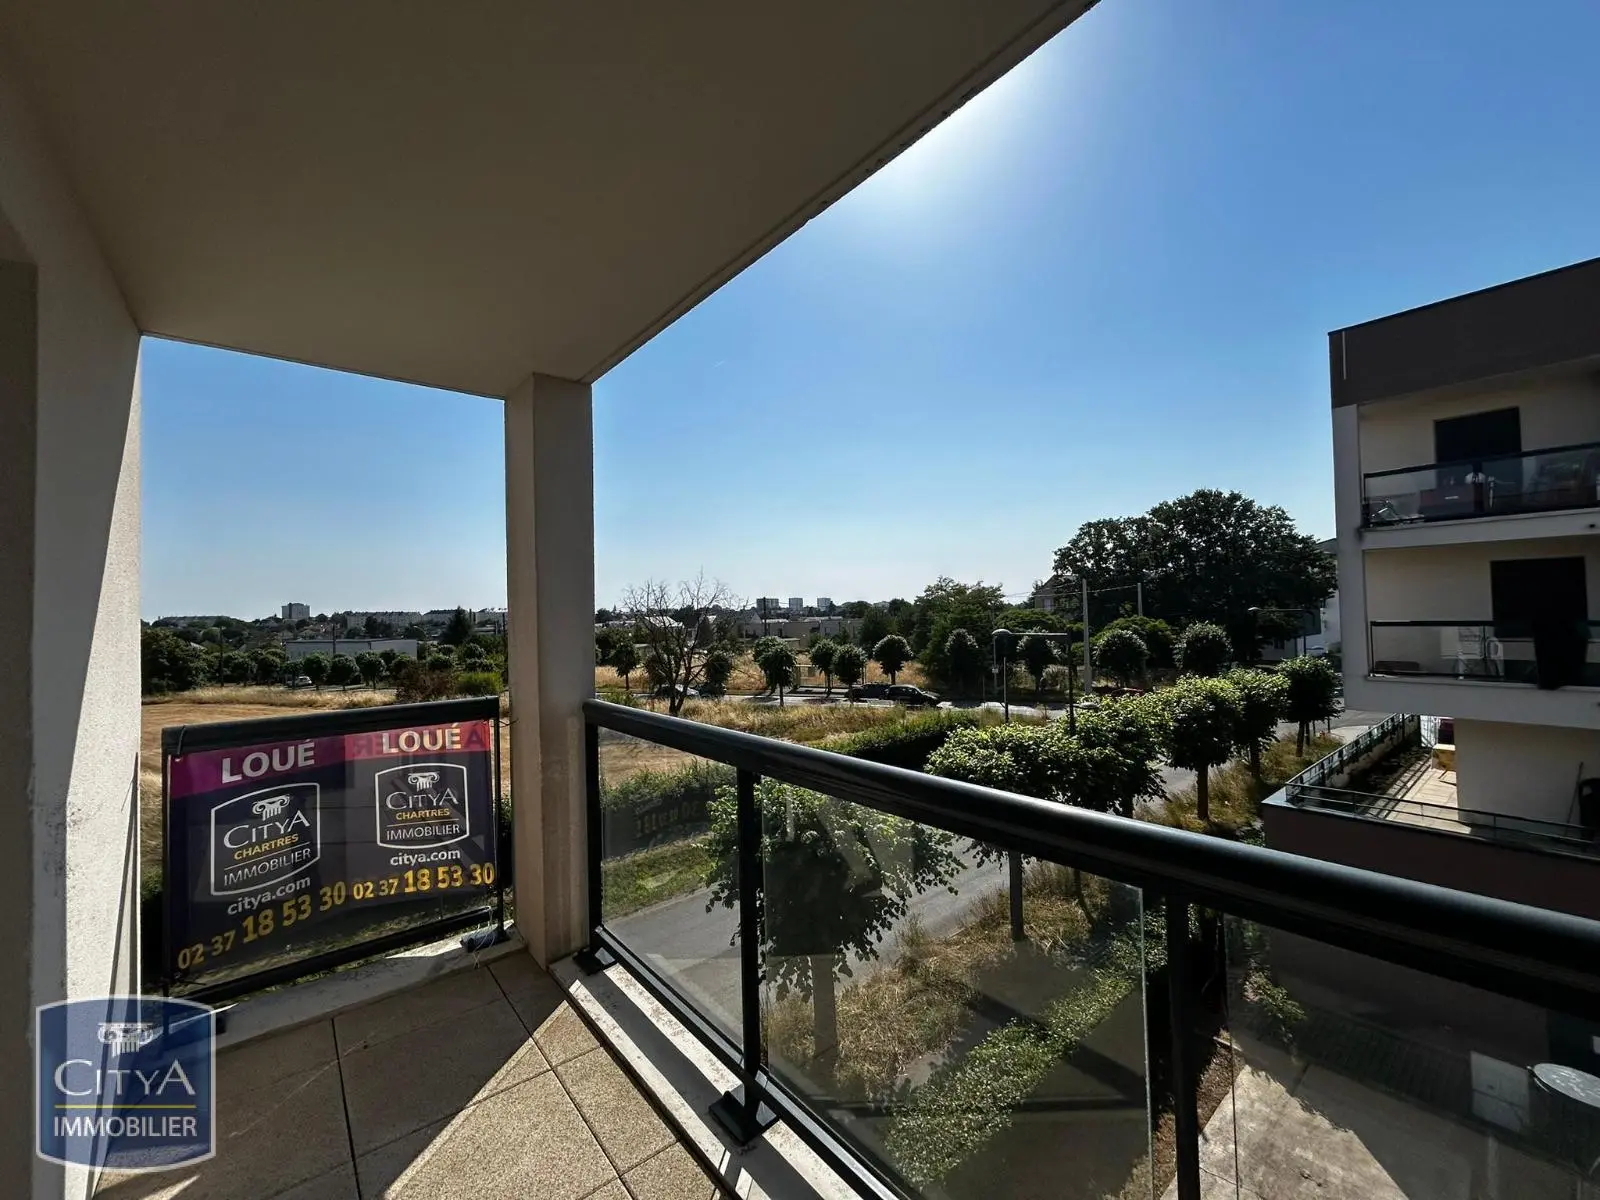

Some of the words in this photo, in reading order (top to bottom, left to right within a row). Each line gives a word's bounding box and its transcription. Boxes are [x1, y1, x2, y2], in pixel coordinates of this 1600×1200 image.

[382, 722, 462, 754] LOUÉ
[221, 739, 316, 784] LOUÉ
[396, 808, 450, 820] CHARTRES
[234, 833, 299, 861] CHARTRES
[387, 824, 460, 841] IMMOBILIER
[224, 848, 311, 886] IMMOBILIER
[390, 849, 461, 866] citya.com
[227, 876, 311, 916] citya.com
[353, 882, 374, 899] 02
[379, 879, 398, 896] 37
[404, 868, 431, 893] 18
[438, 865, 463, 887] 53
[470, 863, 495, 885] 30
[178, 944, 204, 969] 02
[211, 931, 235, 956] 37
[243, 909, 274, 943] 18
[282, 894, 312, 926] 53
[320, 881, 346, 911] 30
